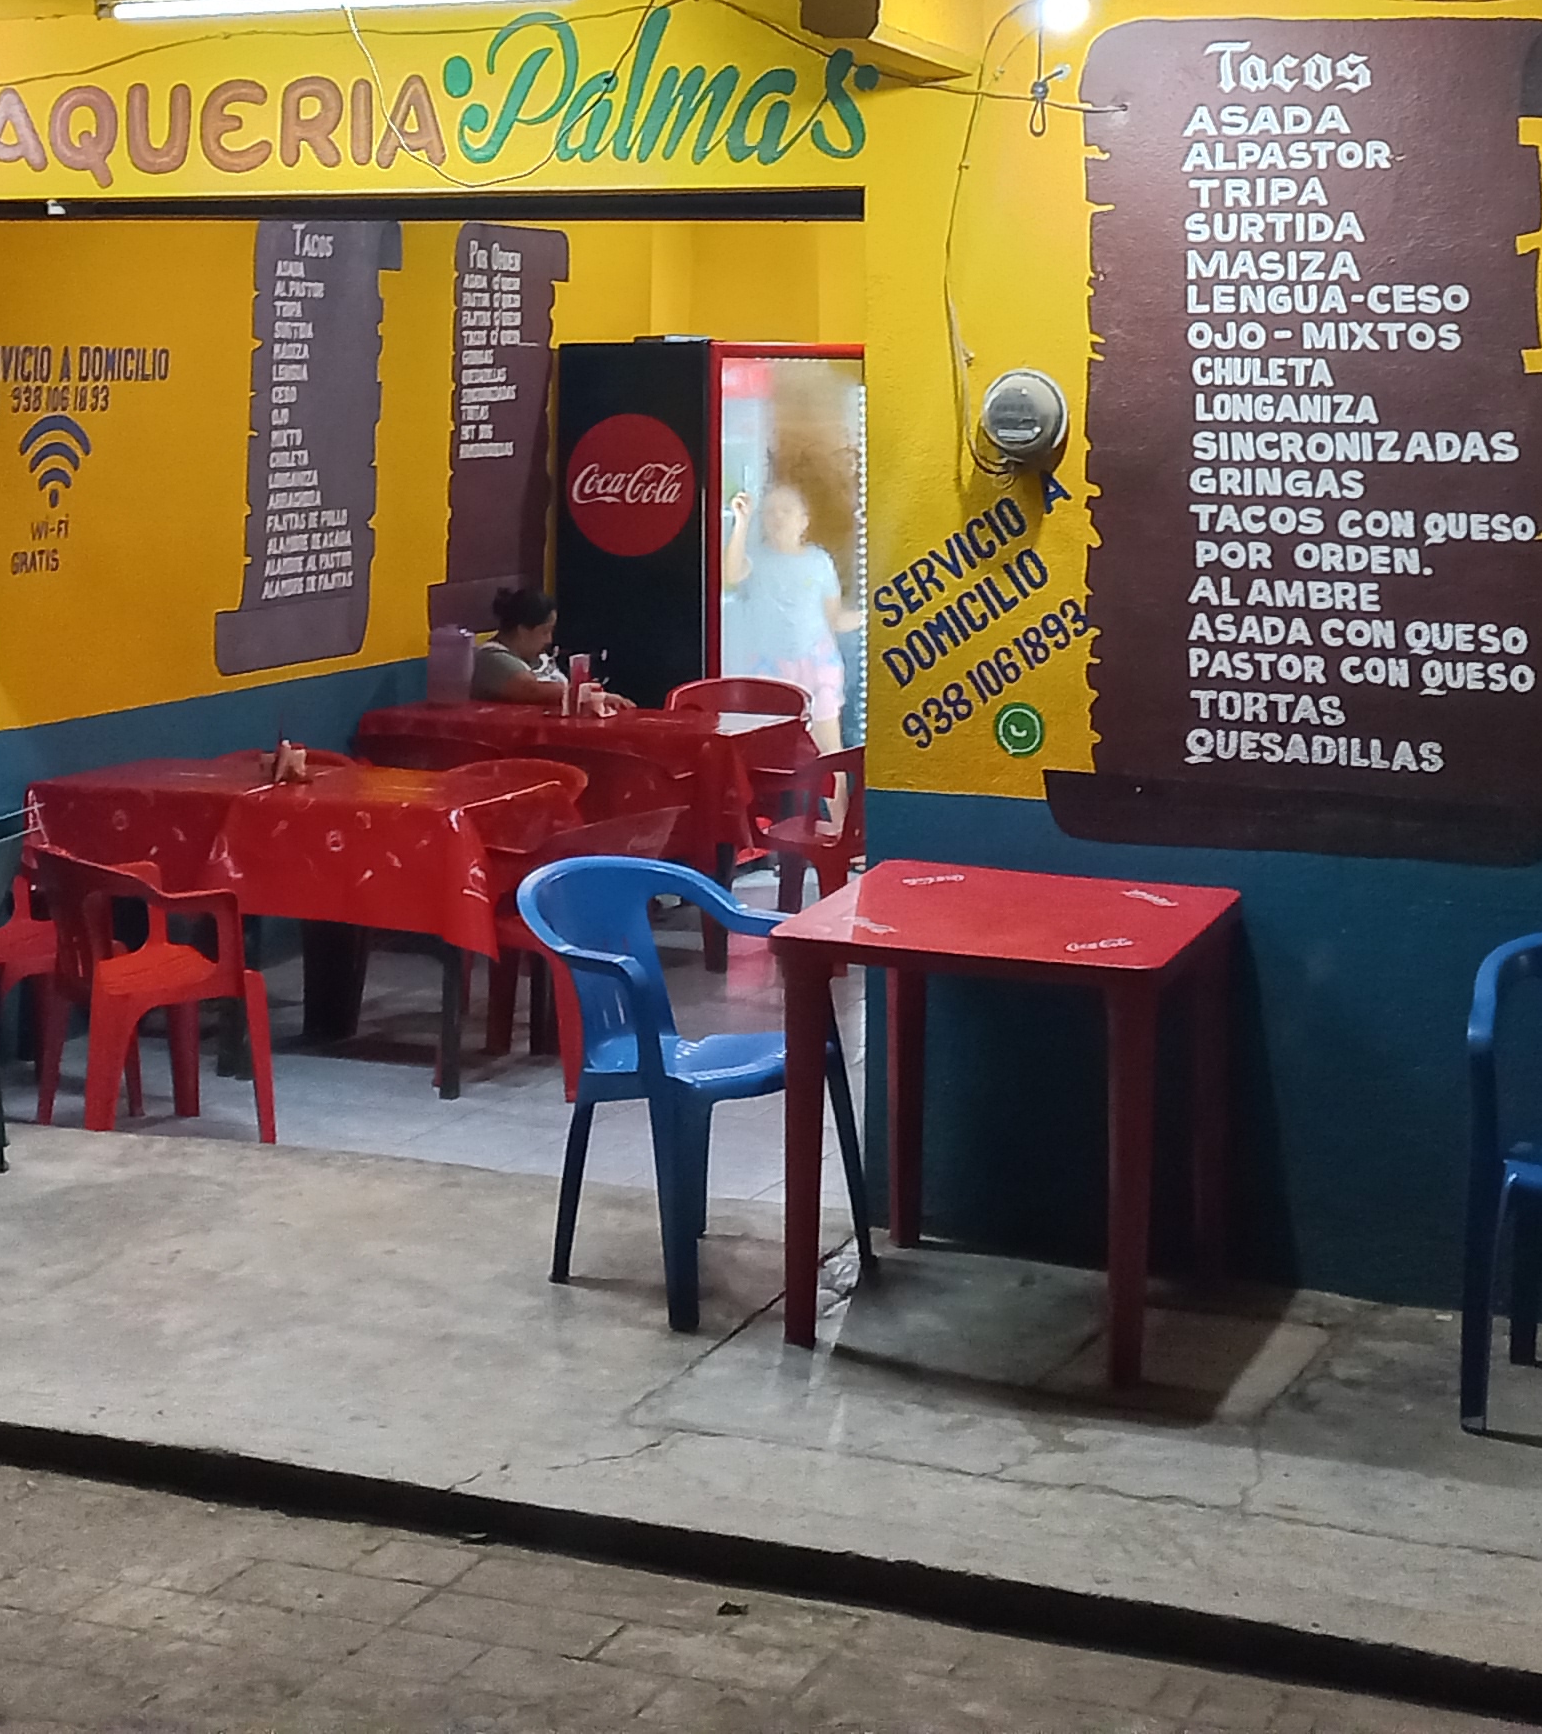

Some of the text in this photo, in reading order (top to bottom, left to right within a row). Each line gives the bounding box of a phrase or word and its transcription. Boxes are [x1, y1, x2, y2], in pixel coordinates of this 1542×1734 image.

[1204, 40, 1373, 94] Tacos
[457, 6, 879, 168] Palmas
[1182, 105, 1351, 137] ASADA
[1187, 176, 1329, 208] TRIPA
[1184, 211, 1366, 244] SURTIDA
[1186, 249, 1361, 282] MASIZA
[1186, 320, 1267, 349] OJO
[1302, 321, 1463, 352] MIXTOS
[59, 345, 72, 382] A
[78, 345, 171, 382] DOMICILIO
[1192, 356, 1335, 388] CHULETA
[11, 384, 43, 413] 938
[1194, 392, 1379, 425] LONGANIZA
[1191, 430, 1520, 464] SINCRONIZADAS
[571, 463, 688, 505] Coca-Cola
[1188, 466, 1366, 499] GRINGAS
[1188, 503, 1537, 547] TACOS CON QUESO
[10, 548, 61, 576] GRATIS
[873, 470, 1072, 628] SERVICIO A
[1194, 540, 1434, 576] POR ORDEN.
[881, 547, 1049, 689] DOMICILIO
[1187, 612, 1529, 656] ASADA CON QUESO
[1188, 647, 1537, 696] PASTOR CON QUESO
[901, 681, 974, 750] 938
[966, 645, 1023, 704] 106
[1189, 689, 1347, 727] TORTAS
[1184, 728, 1446, 773] QUESADILLAS
